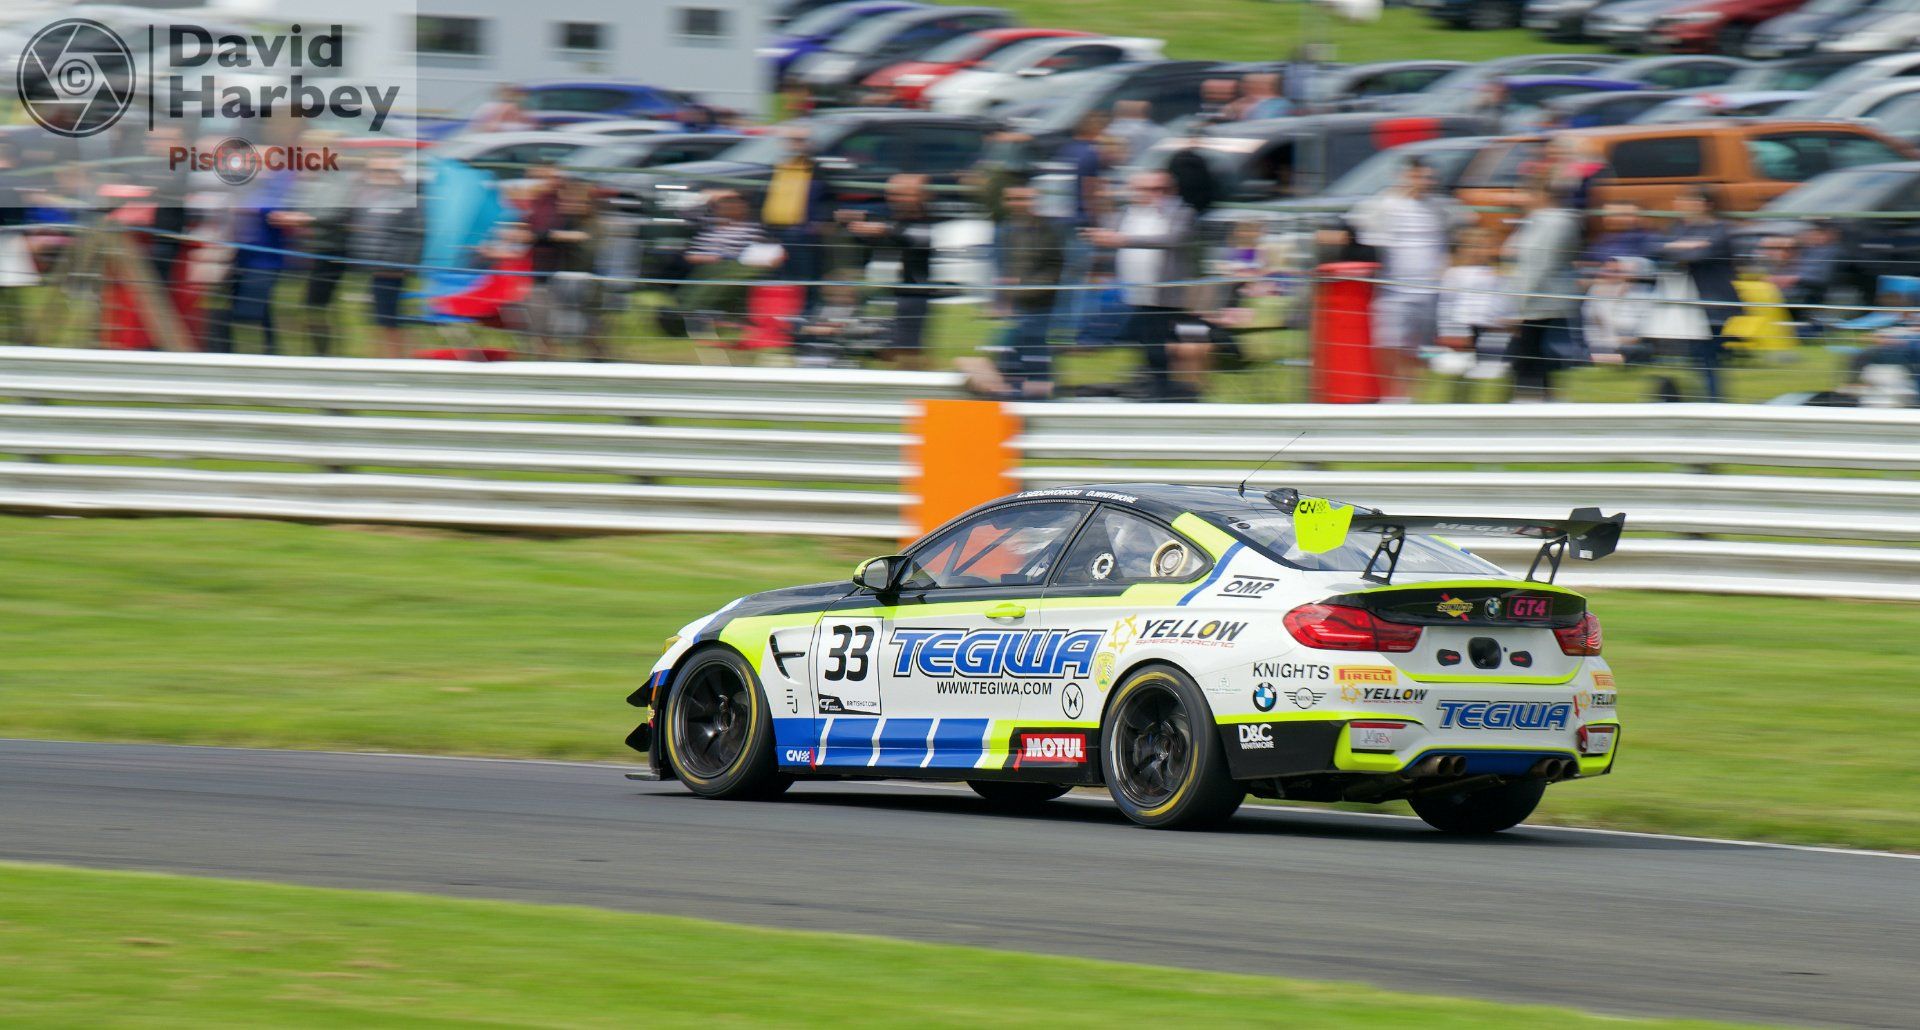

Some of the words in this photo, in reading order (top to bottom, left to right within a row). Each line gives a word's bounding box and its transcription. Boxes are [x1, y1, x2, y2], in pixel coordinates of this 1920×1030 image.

[1223, 580, 1275, 595] OMP
[1513, 599, 1547, 617] GT4
[1139, 619, 1249, 641] YELLOW
[1135, 638, 1178, 647] SPEED
[1180, 640, 1235, 649] RACING
[824, 625, 875, 682] 33
[889, 627, 1107, 680] TEGIWA
[1253, 662, 1330, 680] KNIGHTS
[1338, 668, 1393, 681] PIRELLI
[936, 681, 1053, 696] WWW.TEGIWA.COM
[1363, 687, 1428, 700] YELLOW
[1437, 700, 1573, 730] TEGIWA
[1237, 723, 1274, 743] D&C
[1026, 737, 1084, 759] MOTUL
